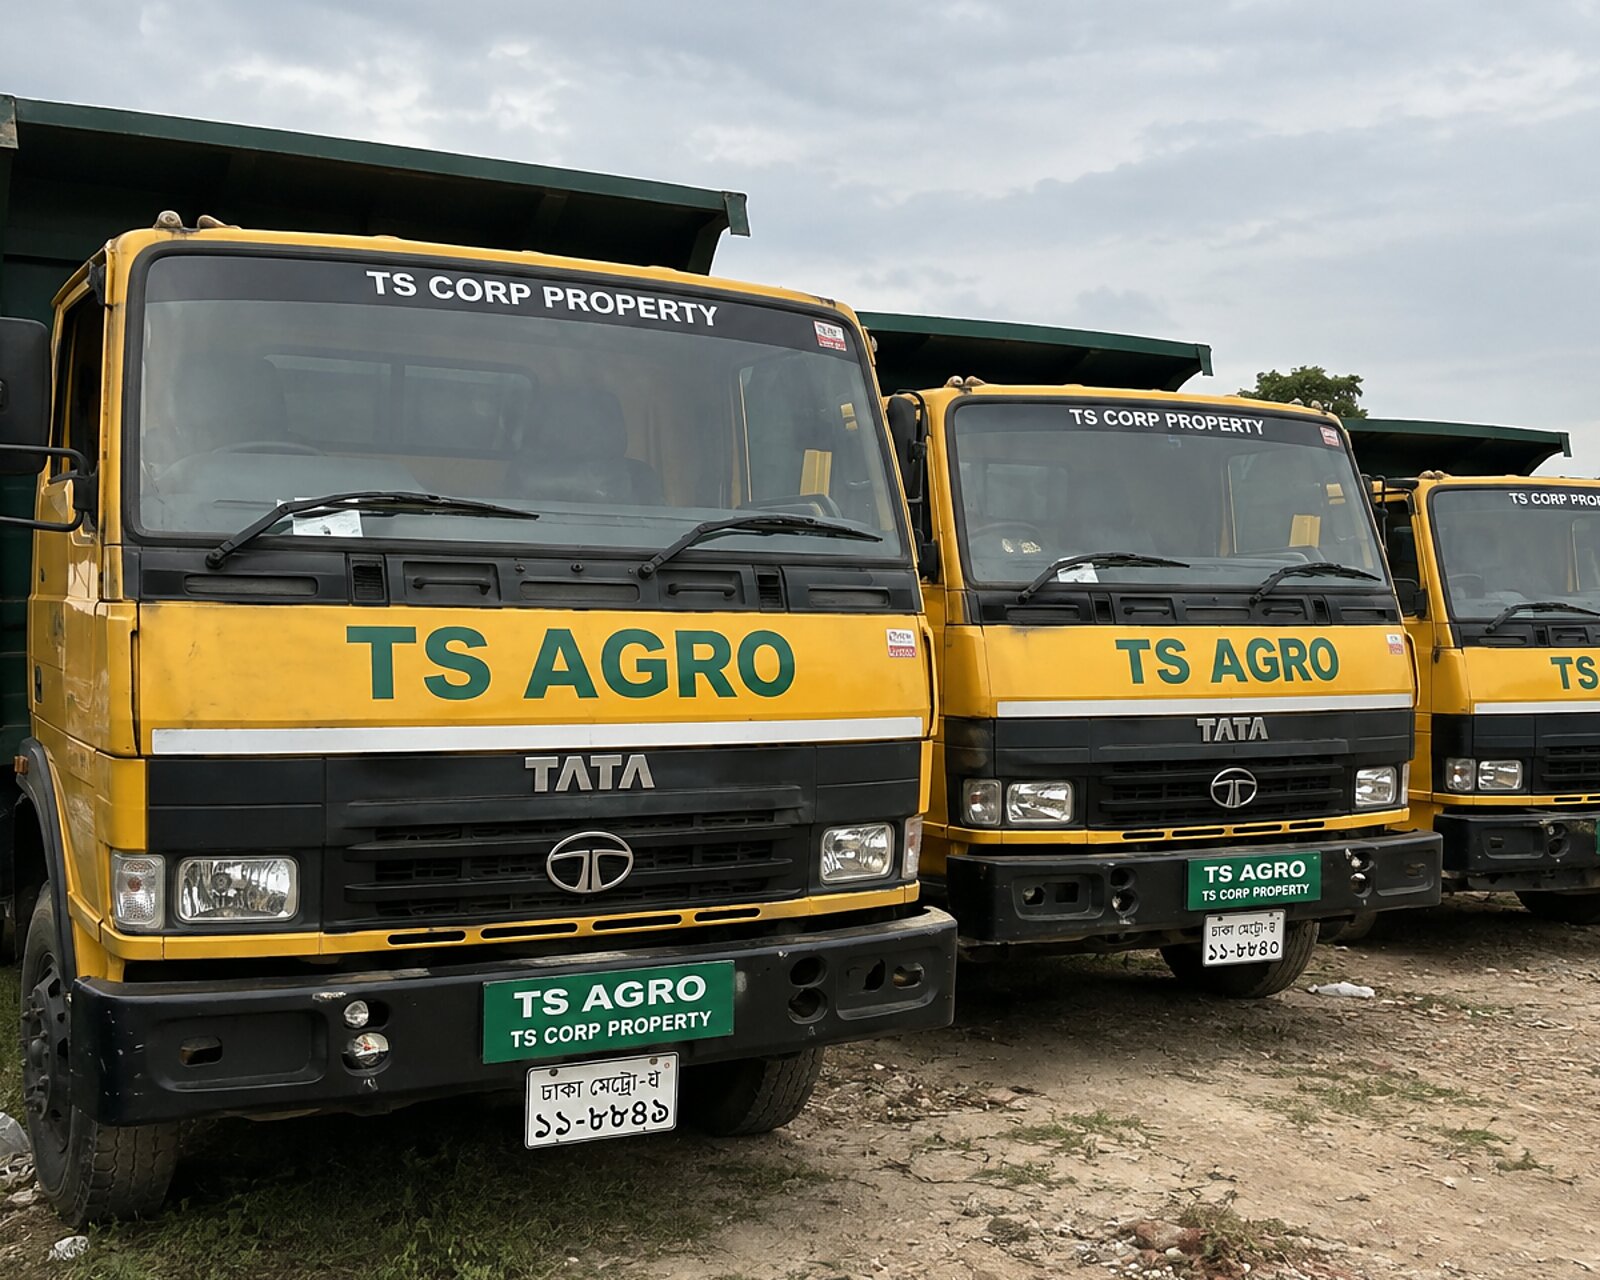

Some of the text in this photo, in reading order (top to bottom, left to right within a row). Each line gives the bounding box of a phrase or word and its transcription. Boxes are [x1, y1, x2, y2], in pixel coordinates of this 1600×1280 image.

[366, 270, 717, 326] TS CORP PROPERTY
[1069, 409, 1263, 434] TS CORP PROPERTY
[1509, 493, 1528, 504] TS
[1531, 493, 1567, 504] CORP
[347, 626, 794, 700] TS AGRO
[1116, 639, 1189, 684] TS
[1212, 638, 1338, 682] AGRO
[1550, 656, 1599, 690] TS
[1197, 717, 1268, 741] TATA
[525, 754, 655, 792] TATA
[1204, 861, 1305, 883] TS AGRO
[1202, 884, 1309, 902] TS CORP PROPERTY
[514, 975, 706, 1017] TS AGRO
[511, 1011, 711, 1047] TS CORP PROPERTY
